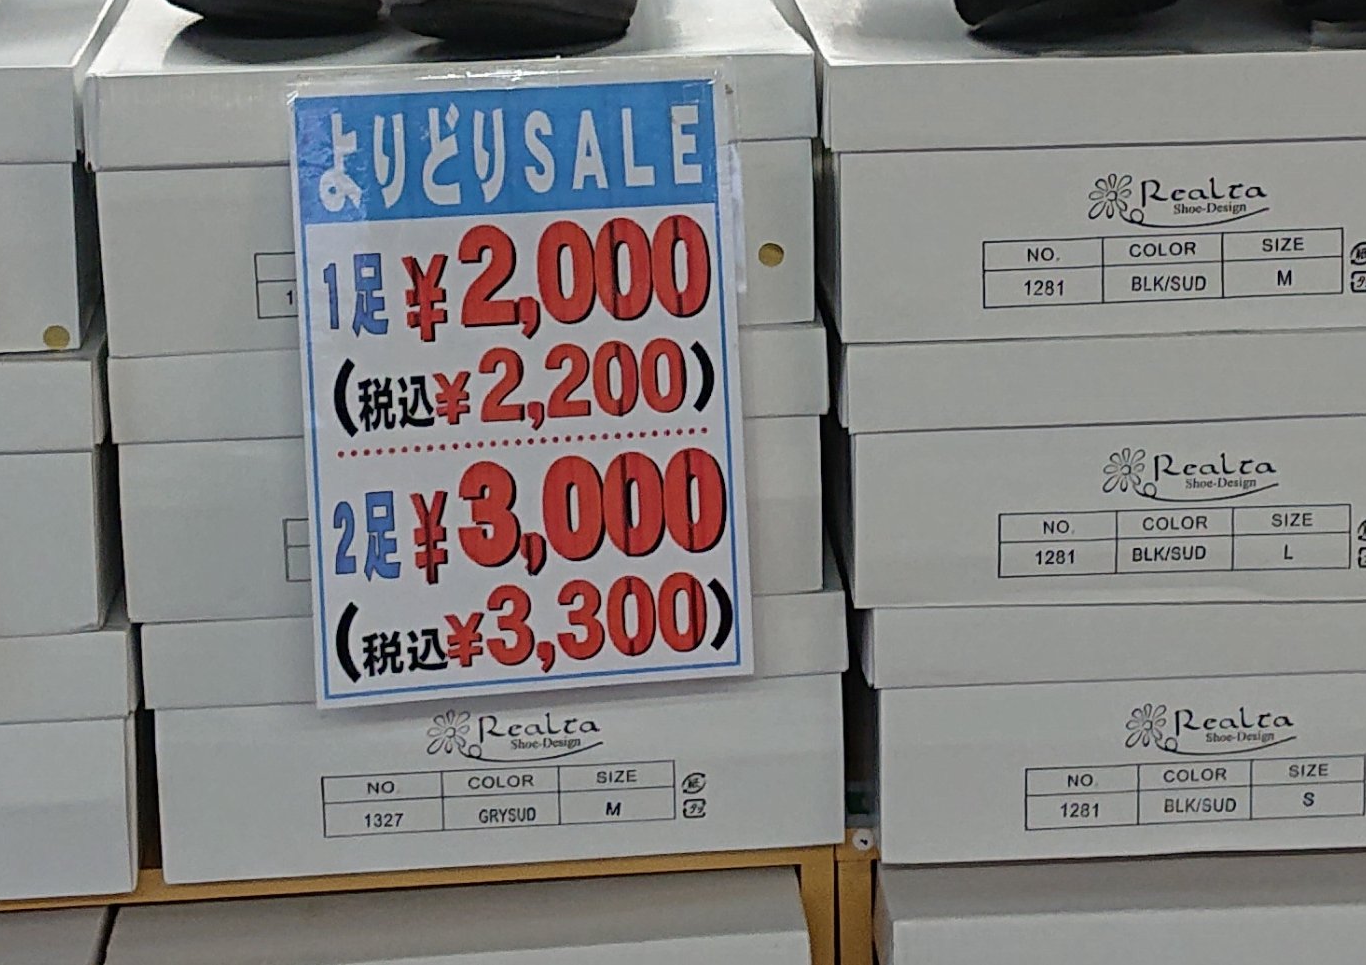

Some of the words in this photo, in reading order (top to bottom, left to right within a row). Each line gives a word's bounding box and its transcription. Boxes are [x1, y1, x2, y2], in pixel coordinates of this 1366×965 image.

[319, 102, 704, 213] よりどりSALE
[1140, 176, 1268, 213] Realta
[1173, 200, 1247, 216] Shoe-Design
[1026, 246, 1062, 263] NO.
[1128, 241, 1197, 258] COLOR
[1261, 236, 1305, 253] SIZE
[323, 254, 389, 335] 1足
[404, 213, 712, 344] ¥2,000
[1023, 279, 1065, 297] 1281
[1130, 275, 1207, 293] BLK/SUD
[1276, 269, 1293, 287] M
[333, 338, 715, 438] (税込¥2,200)
[1153, 451, 1278, 488] Realta
[1185, 476, 1257, 491] Shoe-Design
[333, 490, 402, 580] 2足
[410, 448, 728, 586] ¥3,000
[1142, 515, 1209, 532] COLOR
[1270, 512, 1314, 528] SIZE
[1034, 548, 1075, 566] 1281
[1131, 544, 1207, 563] BLK/SUD
[1283, 543, 1294, 561] L
[336, 573, 734, 682] (税込¥3,300)
[478, 711, 601, 745] Realta
[1173, 706, 1295, 742] Realta
[510, 737, 582, 751] Shoe-Design
[467, 774, 535, 791] COLOR
[595, 768, 638, 785] SIZE
[1162, 767, 1228, 784] COLOR
[1288, 762, 1329, 779] SIZE
[364, 812, 404, 829] 1327
[478, 806, 537, 825] GRYSUD
[605, 801, 622, 817] M
[1059, 802, 1099, 819] 1281
[1163, 797, 1237, 814] BLK/SUD
[1302, 791, 1316, 808] S
